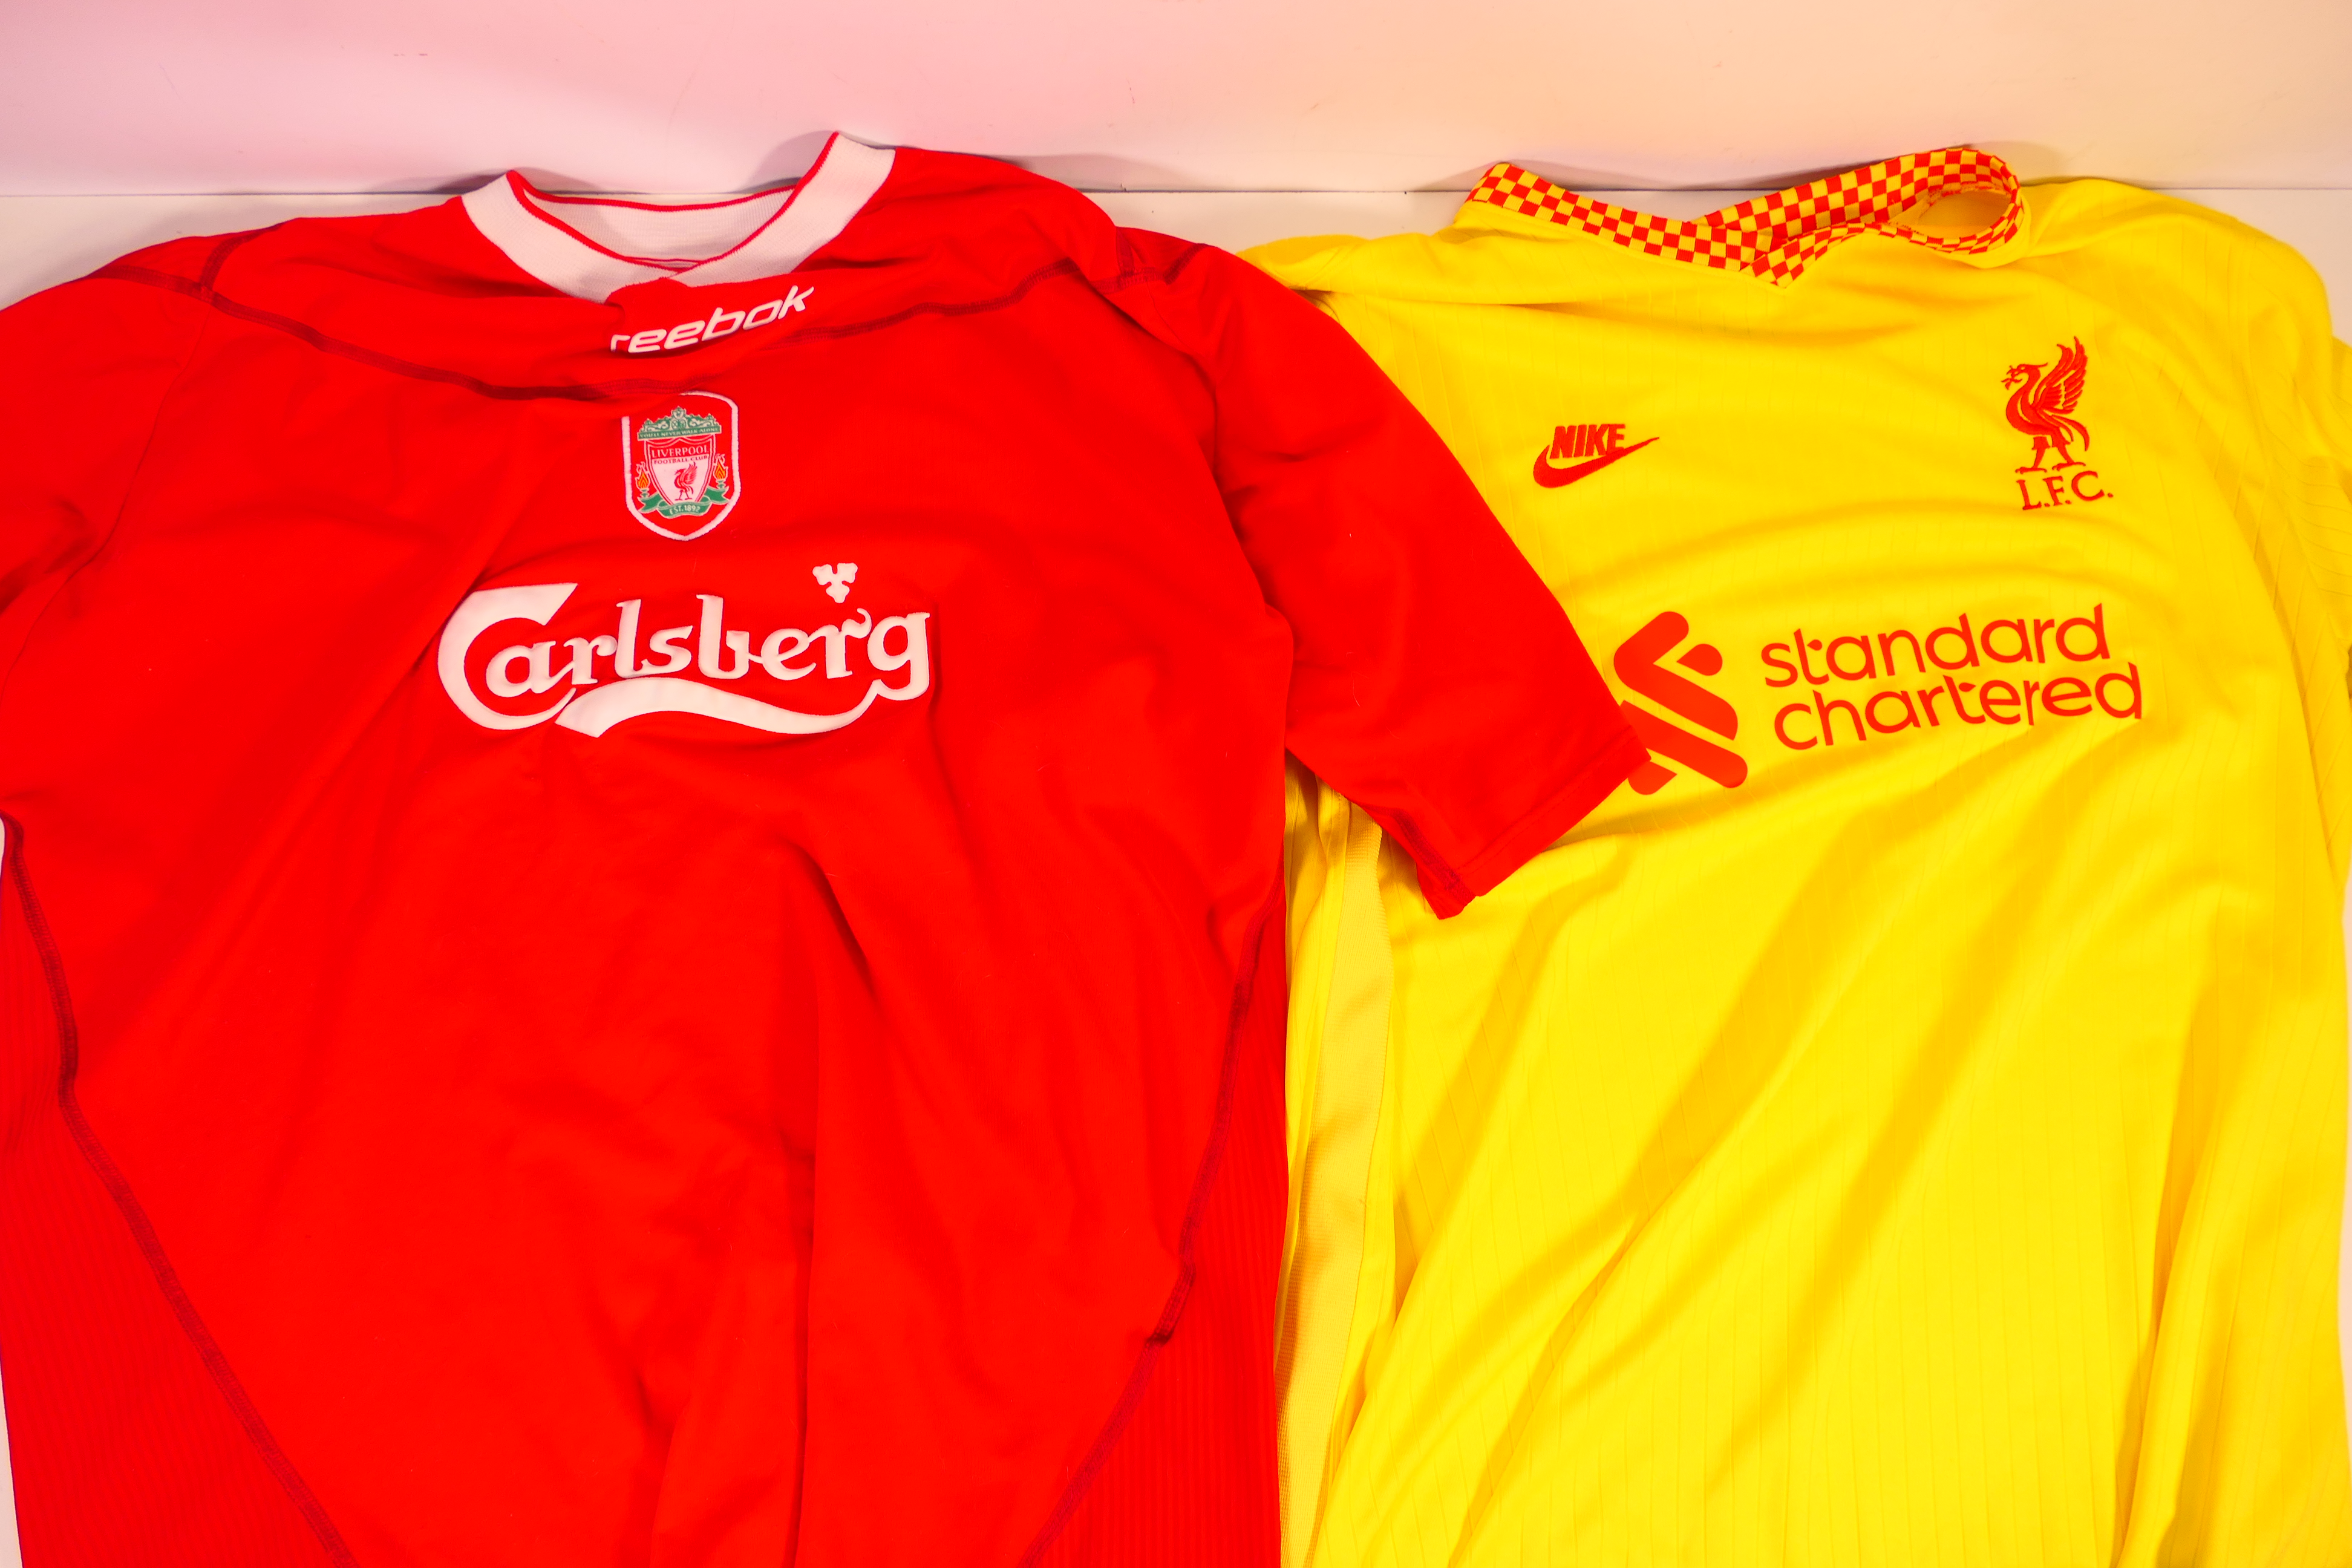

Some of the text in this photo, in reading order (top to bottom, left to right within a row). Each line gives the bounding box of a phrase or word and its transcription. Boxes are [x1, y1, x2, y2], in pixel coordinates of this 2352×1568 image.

[610, 285, 814, 353] reebok
[652, 445, 709, 458] LIVERPOOL
[1549, 423, 1626, 459] NIKE
[2016, 470, 2114, 511] L.F.C.
[437, 582, 931, 738] Carlsberg
[1761, 603, 2111, 688] standard
[1774, 662, 2142, 750] chartered
